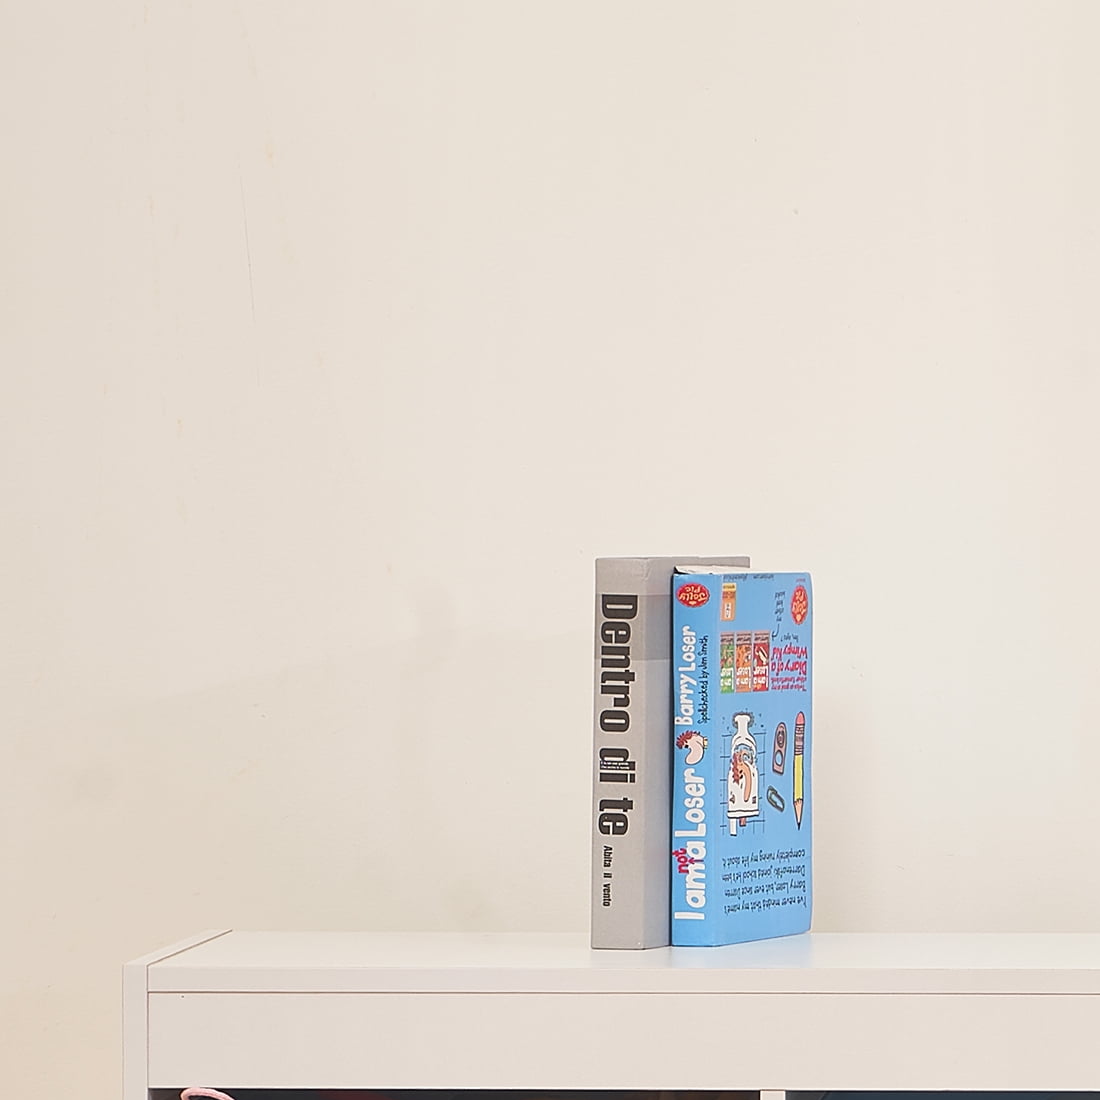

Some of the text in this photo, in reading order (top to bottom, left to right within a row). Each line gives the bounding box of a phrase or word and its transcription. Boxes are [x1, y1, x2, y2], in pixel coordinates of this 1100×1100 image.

[679, 592, 707, 602] Jolly
[698, 635, 708, 656] Smith
[783, 642, 808, 659] Wimpy
[600, 594, 639, 732] Dentro
[699, 657, 708, 669] Jim
[771, 659, 807, 676] Diary of a
[675, 626, 697, 725] Barry Loser
[699, 670, 710, 678] by
[599, 748, 637, 784] di
[598, 797, 634, 836] te
[674, 768, 706, 920] I am a Loser
[603, 846, 613, 868] Abita
[672, 848, 689, 874] not
[751, 853, 758, 862] my
[754, 885, 764, 894] ever
[765, 884, 773, 894] but
[790, 879, 806, 892] Barry
[602, 883, 611, 907] vento
[782, 898, 795, 906] never
[797, 896, 807, 908] I've
[742, 900, 749, 910] my
